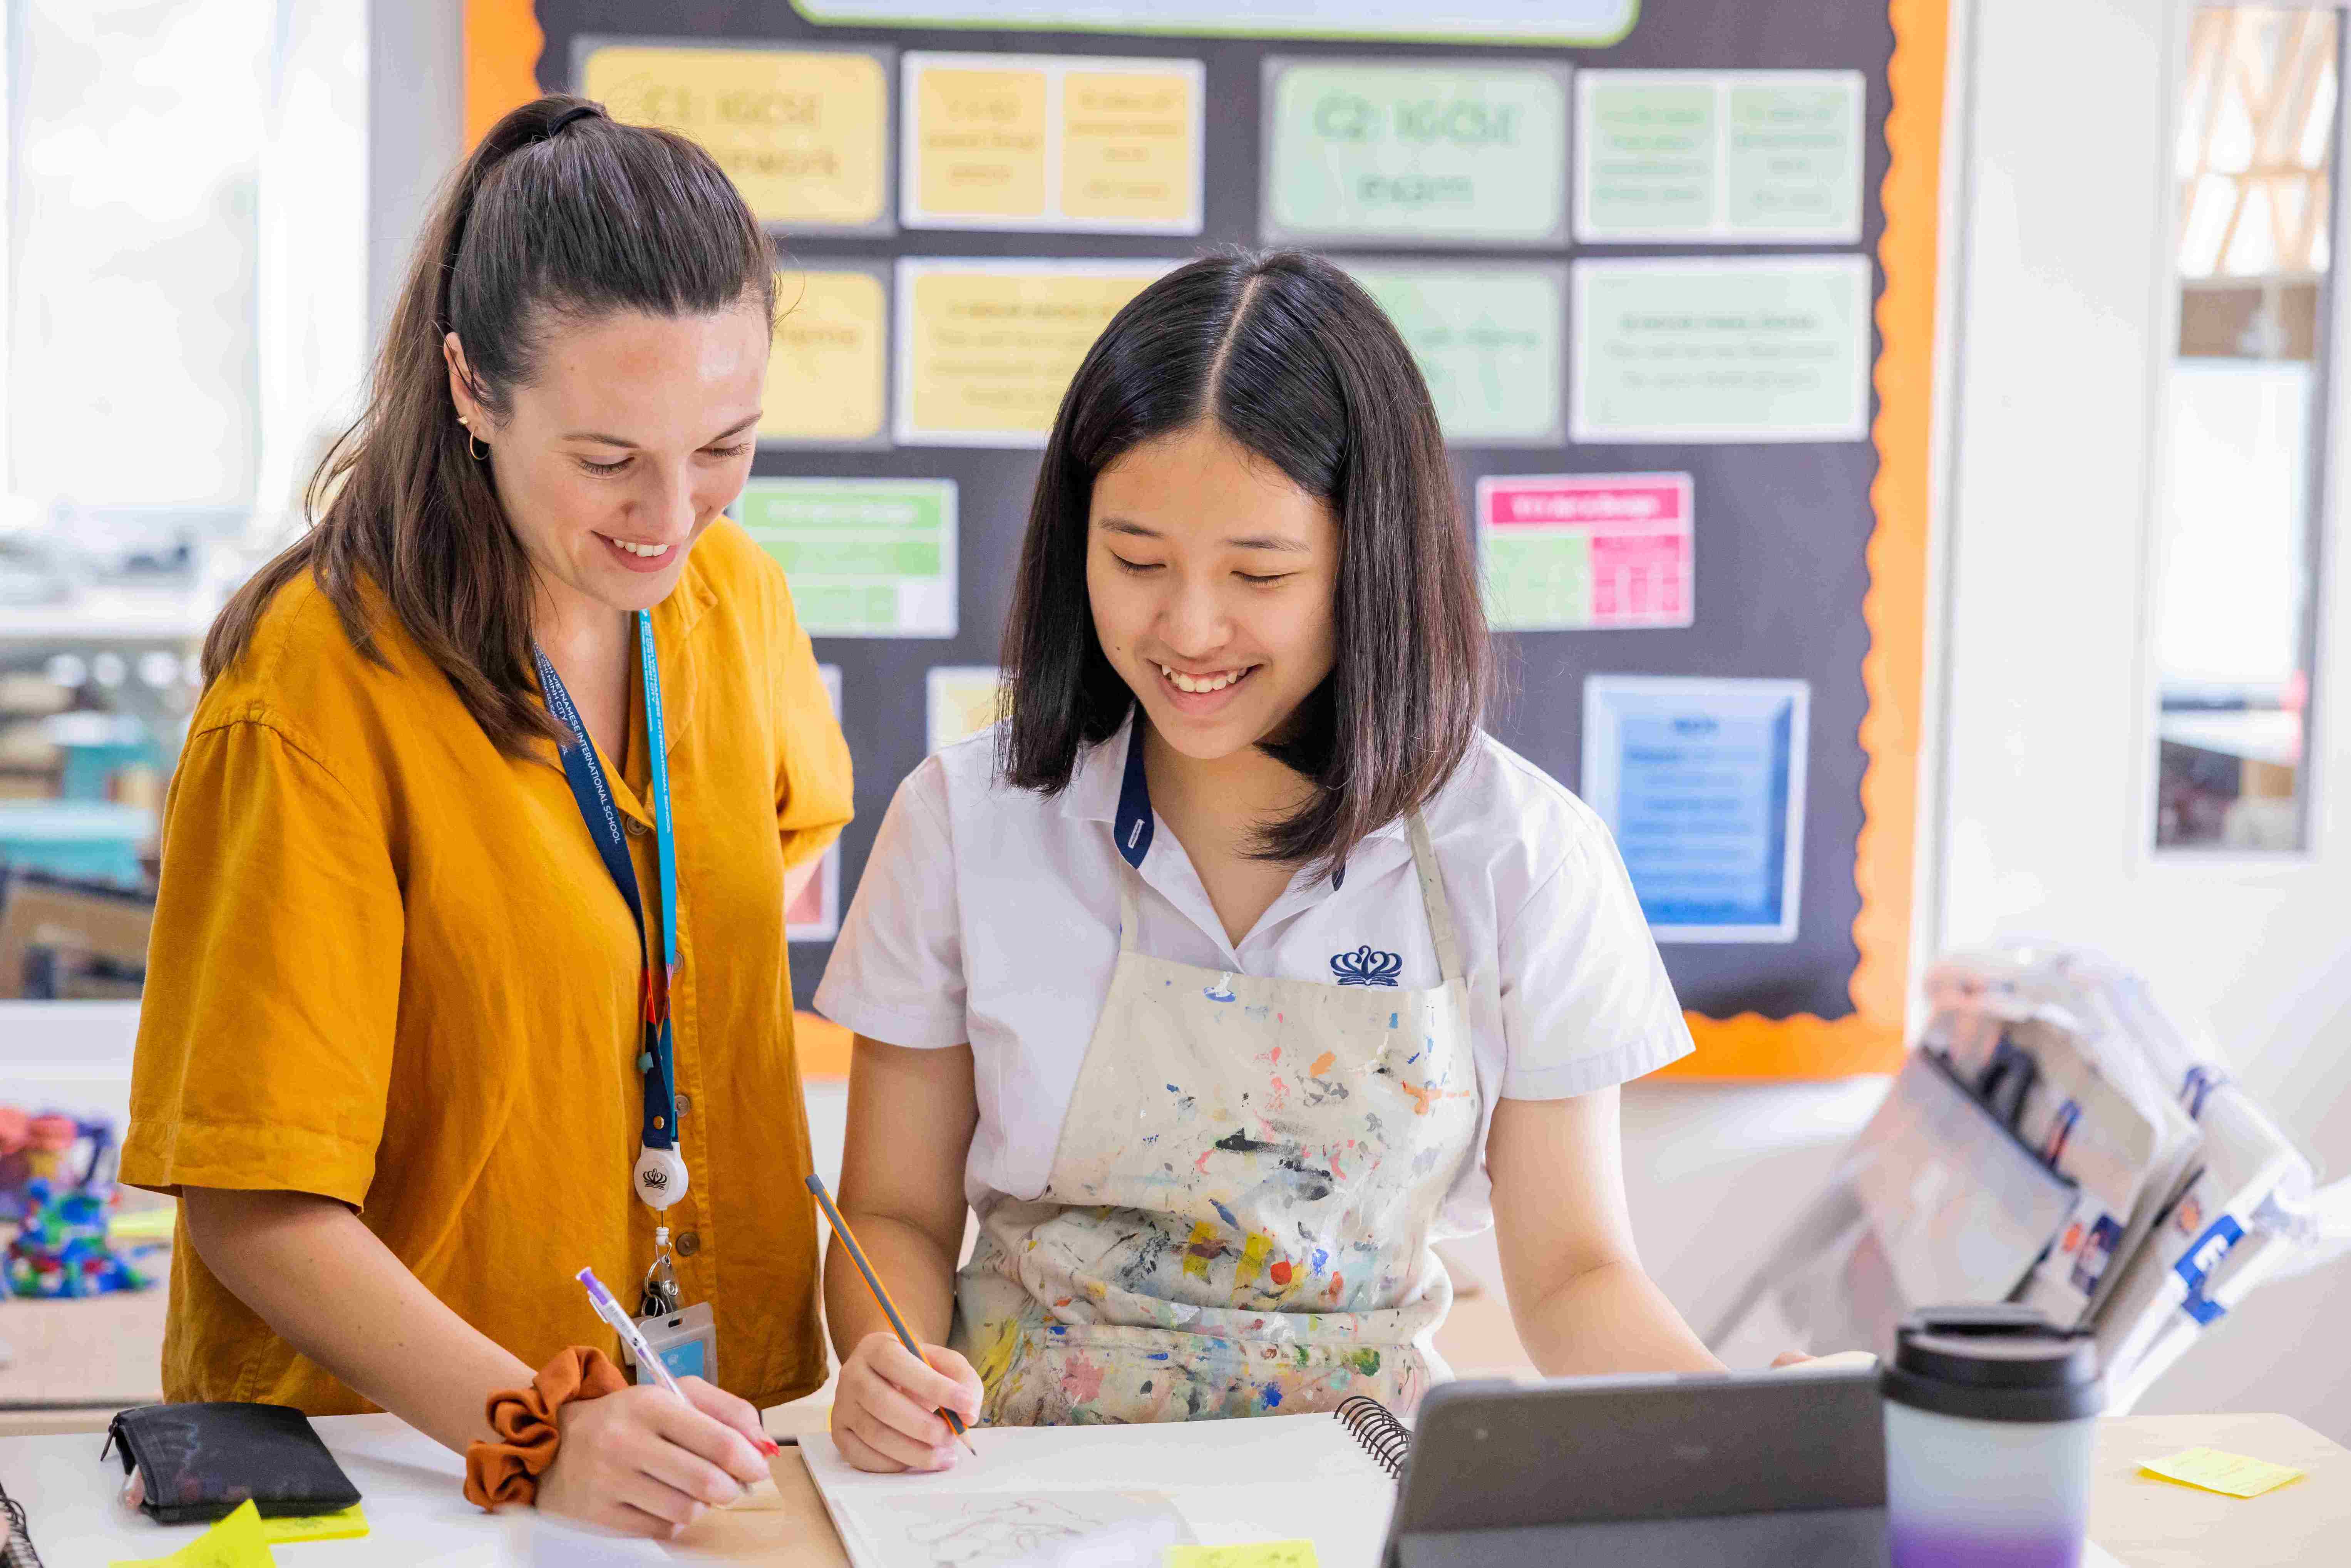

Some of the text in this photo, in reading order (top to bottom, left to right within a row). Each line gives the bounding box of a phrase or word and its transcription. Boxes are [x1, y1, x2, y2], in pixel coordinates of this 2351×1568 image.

[547, 675, 559, 700] MINH
[557, 701, 568, 720] CITY
[553, 674, 580, 732] VIETNAMESE
[576, 732, 608, 805] INTERNATIONAL
[603, 805, 621, 844] SCHOOL
[658, 719, 667, 794] INTERNATIONAL
